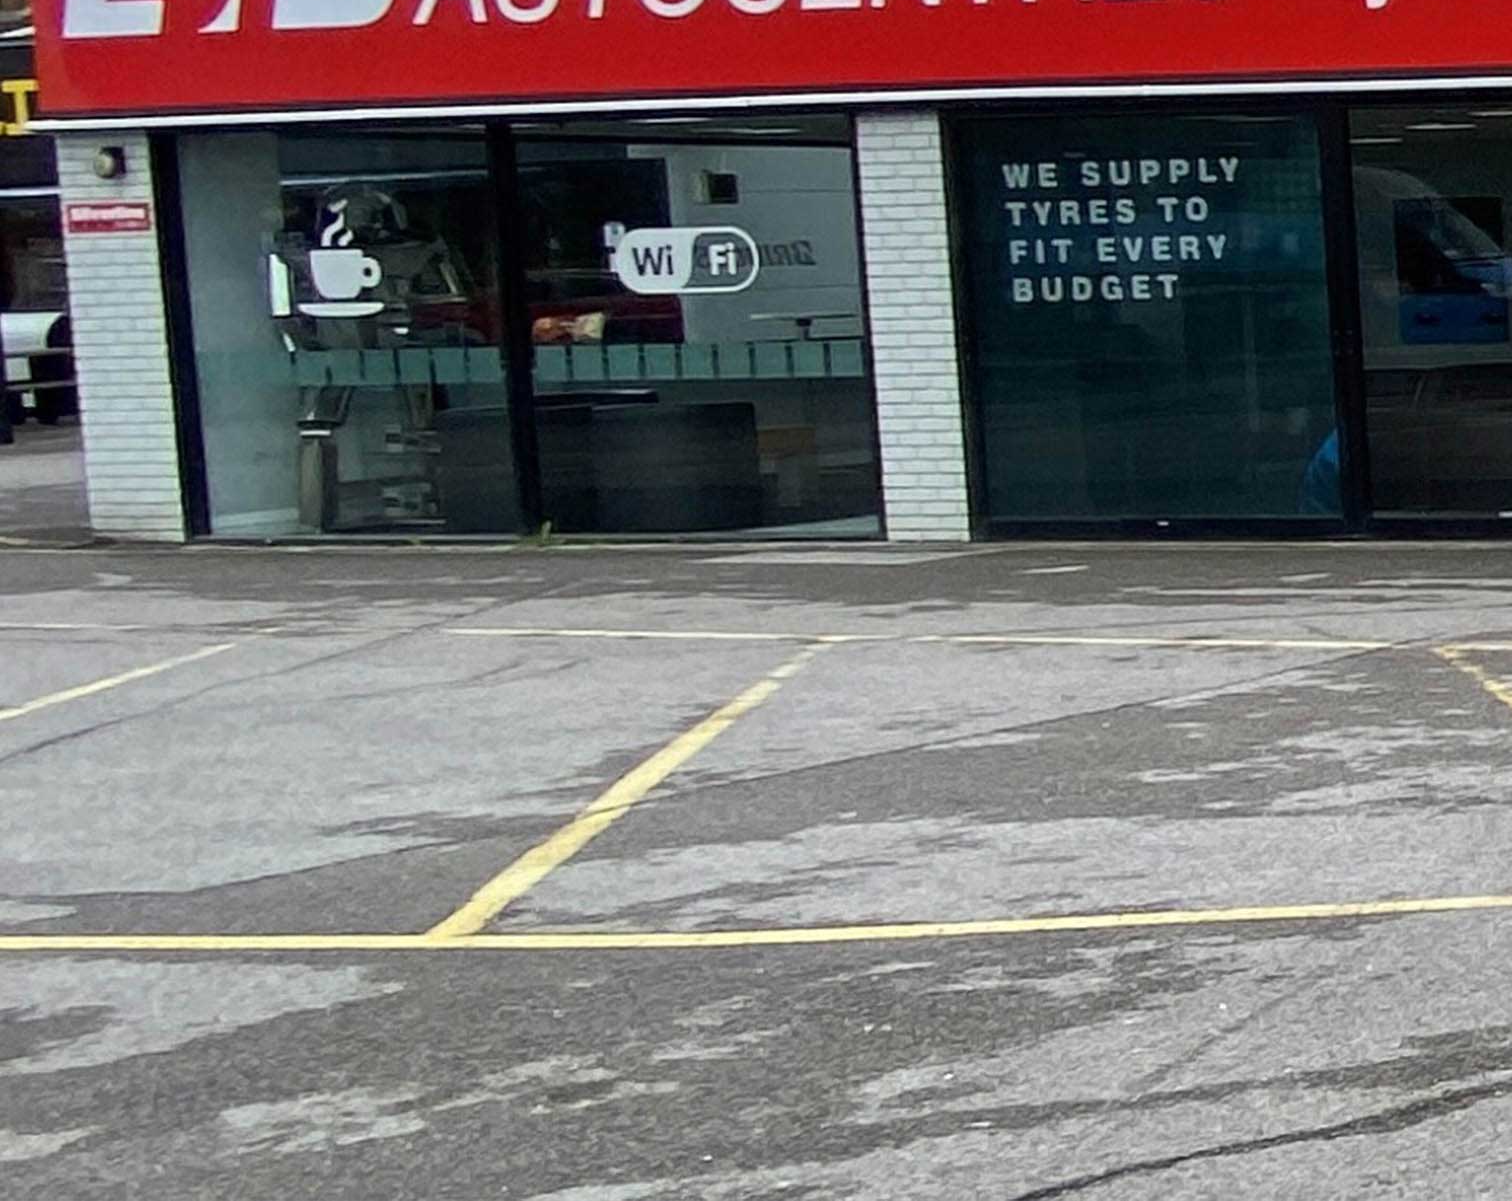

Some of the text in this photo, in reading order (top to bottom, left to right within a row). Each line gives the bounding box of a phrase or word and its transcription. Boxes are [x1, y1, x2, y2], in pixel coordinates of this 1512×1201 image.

[1002, 157, 1239, 188] WE SUPPLY
[1004, 196, 1209, 226] TYRES TO
[632, 244, 674, 276] Wi
[708, 241, 736, 275] Fi
[1009, 234, 1226, 264] FIT EVERY
[1012, 274, 1179, 302] BUDGET
